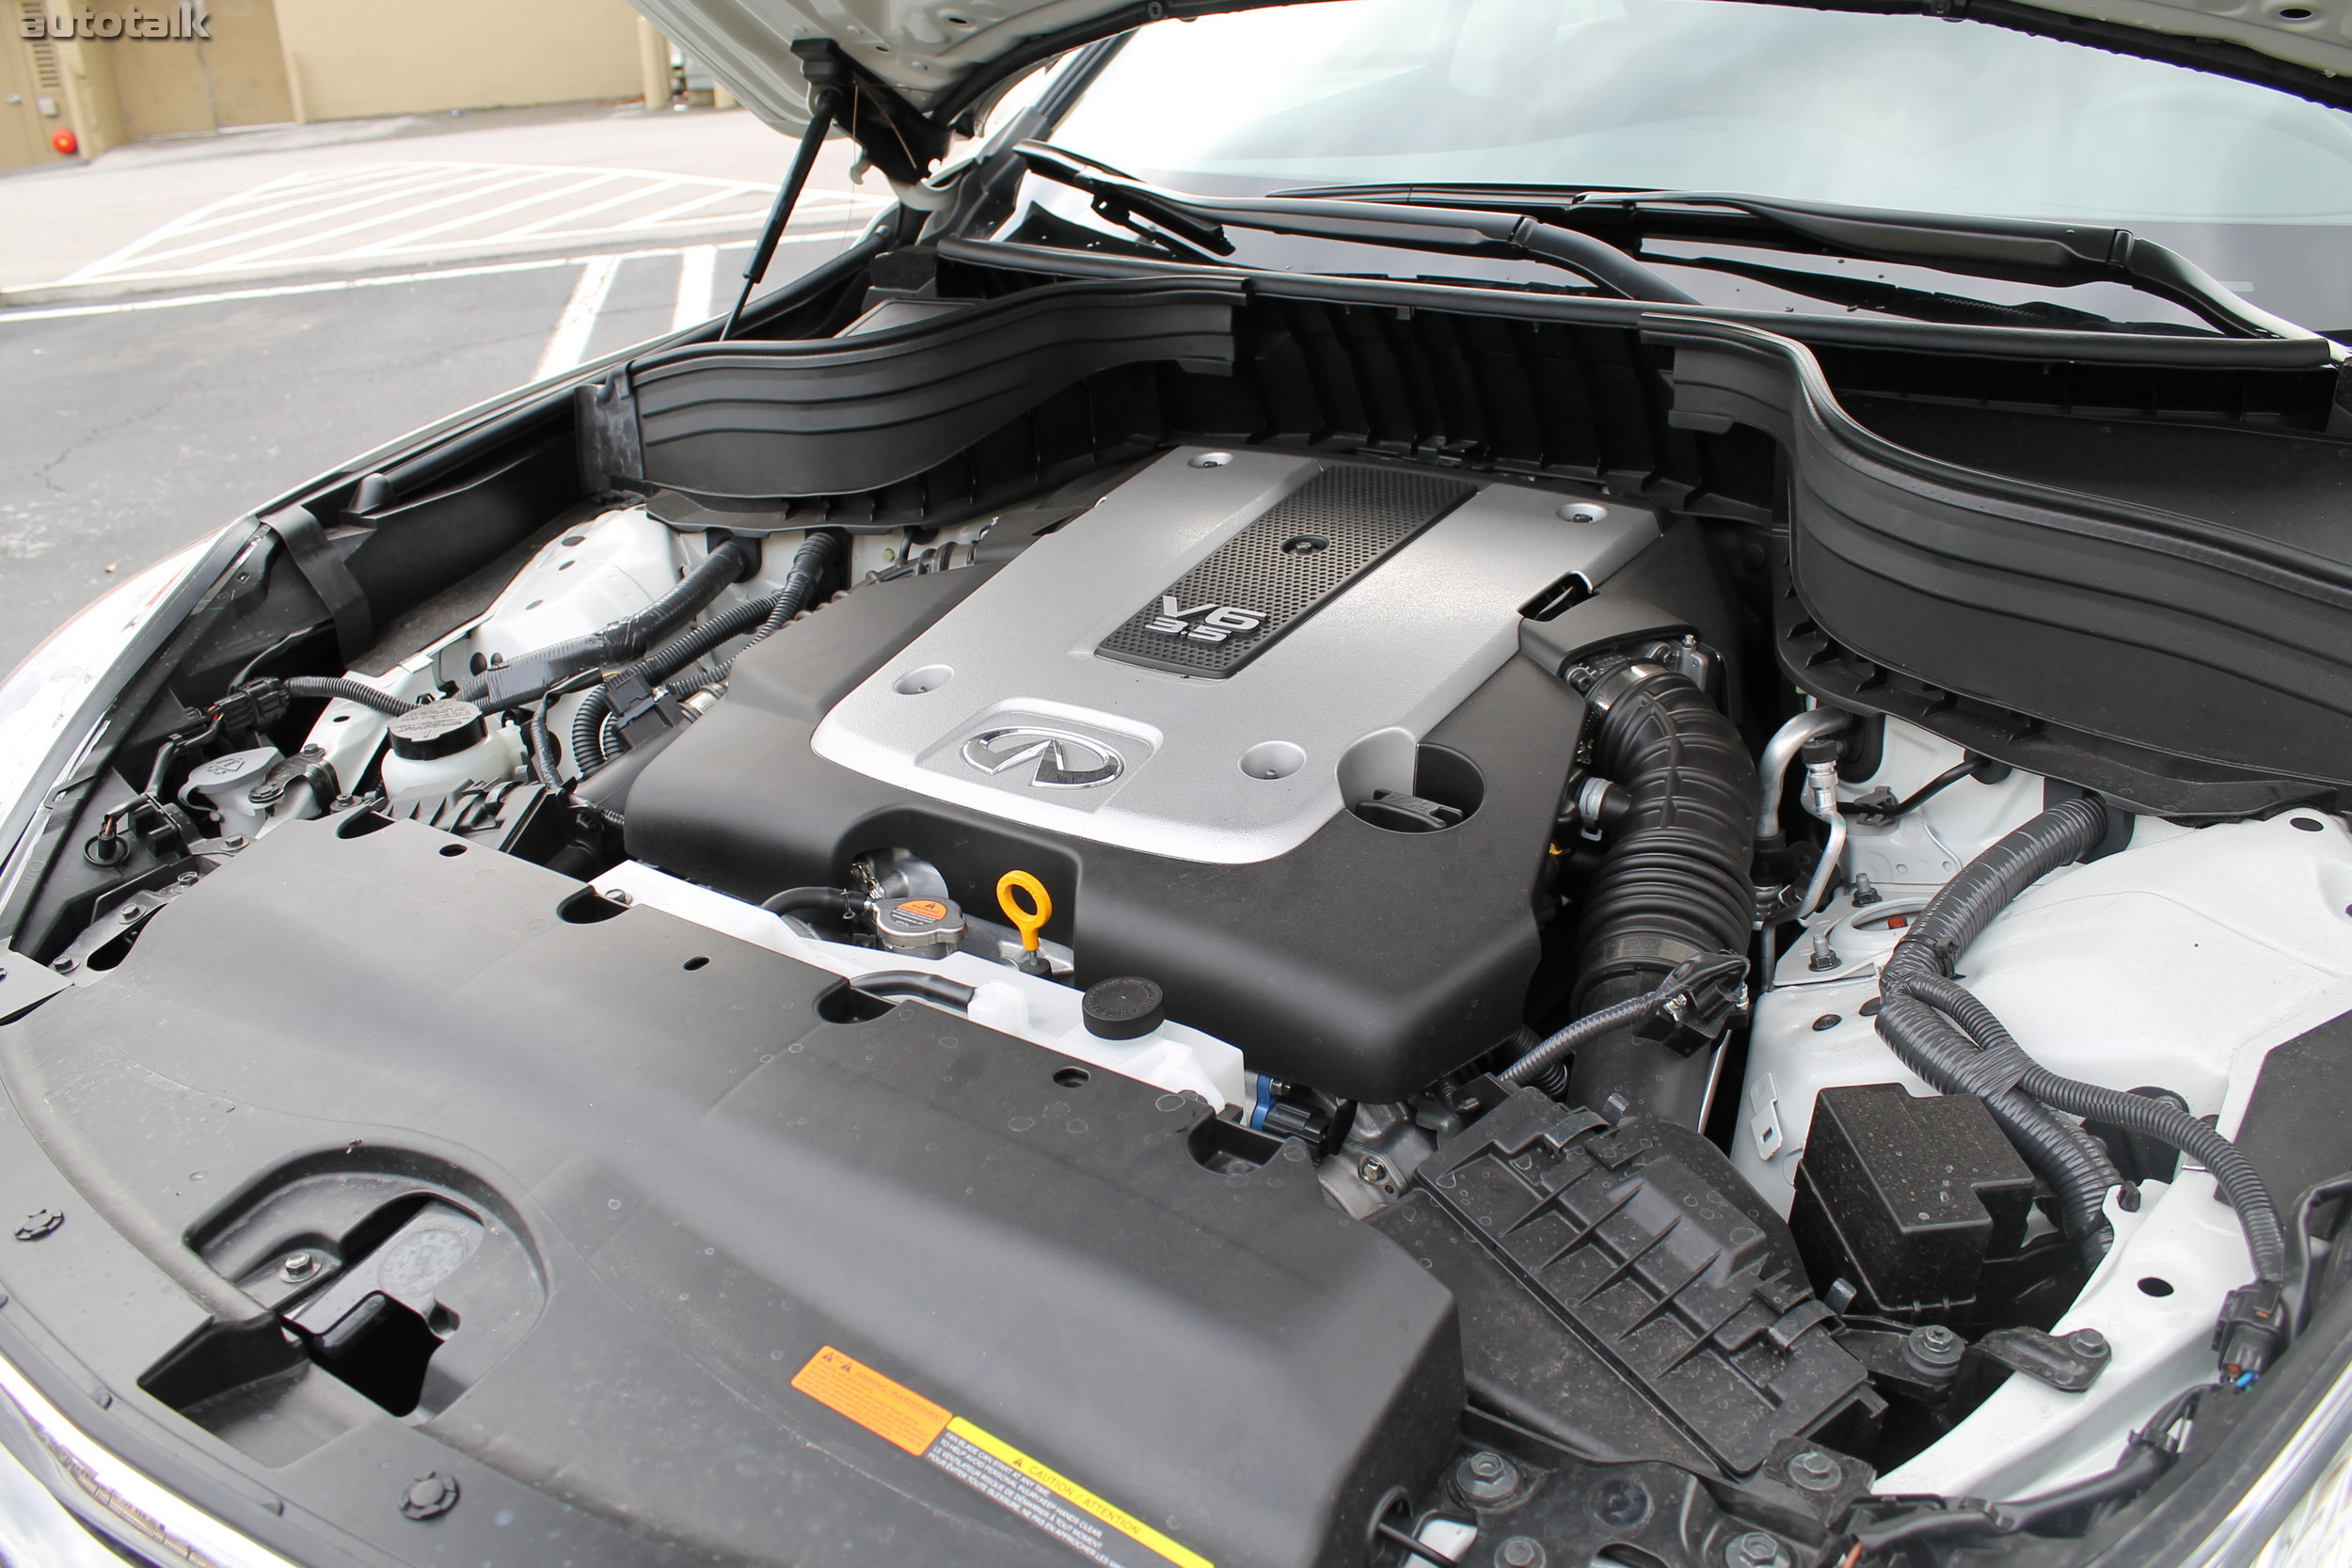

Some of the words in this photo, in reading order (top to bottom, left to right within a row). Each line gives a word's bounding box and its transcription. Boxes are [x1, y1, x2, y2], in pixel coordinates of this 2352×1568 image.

[1145, 616, 1232, 642] 3.5
[1162, 594, 1268, 633] V6
[853, 1370, 887, 1392] WARNING
[932, 1445, 944, 1455] LE
[941, 1449, 981, 1478] VENTILATEUR
[978, 1472, 1005, 1492] RISQUE
[1003, 1486, 1015, 1497] DE
[1054, 1516, 1073, 1532] TOUT
[938, 1438, 950, 1449] TO
[947, 1443, 966, 1458] HELP
[963, 1452, 986, 1469] AVOID
[983, 1464, 1019, 1489] PERSONAL
[1055, 1506, 1080, 1525] HANDS
[945, 1431, 959, 1444] FAN
[957, 1438, 979, 1455] BLADE
[977, 1449, 993, 1464] CAN
[991, 1458, 1012, 1475] START
[1010, 1470, 1021, 1480] AT
[1019, 1475, 1035, 1488] ANY
[926, 1451, 946, 1467] POUR
[966, 1475, 988, 1492] TOUTE
[1021, 1508, 1032, 1518] NE
[1030, 1513, 1045, 1526] PAS
[1043, 1521, 1056, 1532] EN
[1053, 1527, 1097, 1557] APPROCHER
[1027, 1465, 1074, 1497] CAUTION
[1082, 1497, 1140, 1536] ATTENTION
